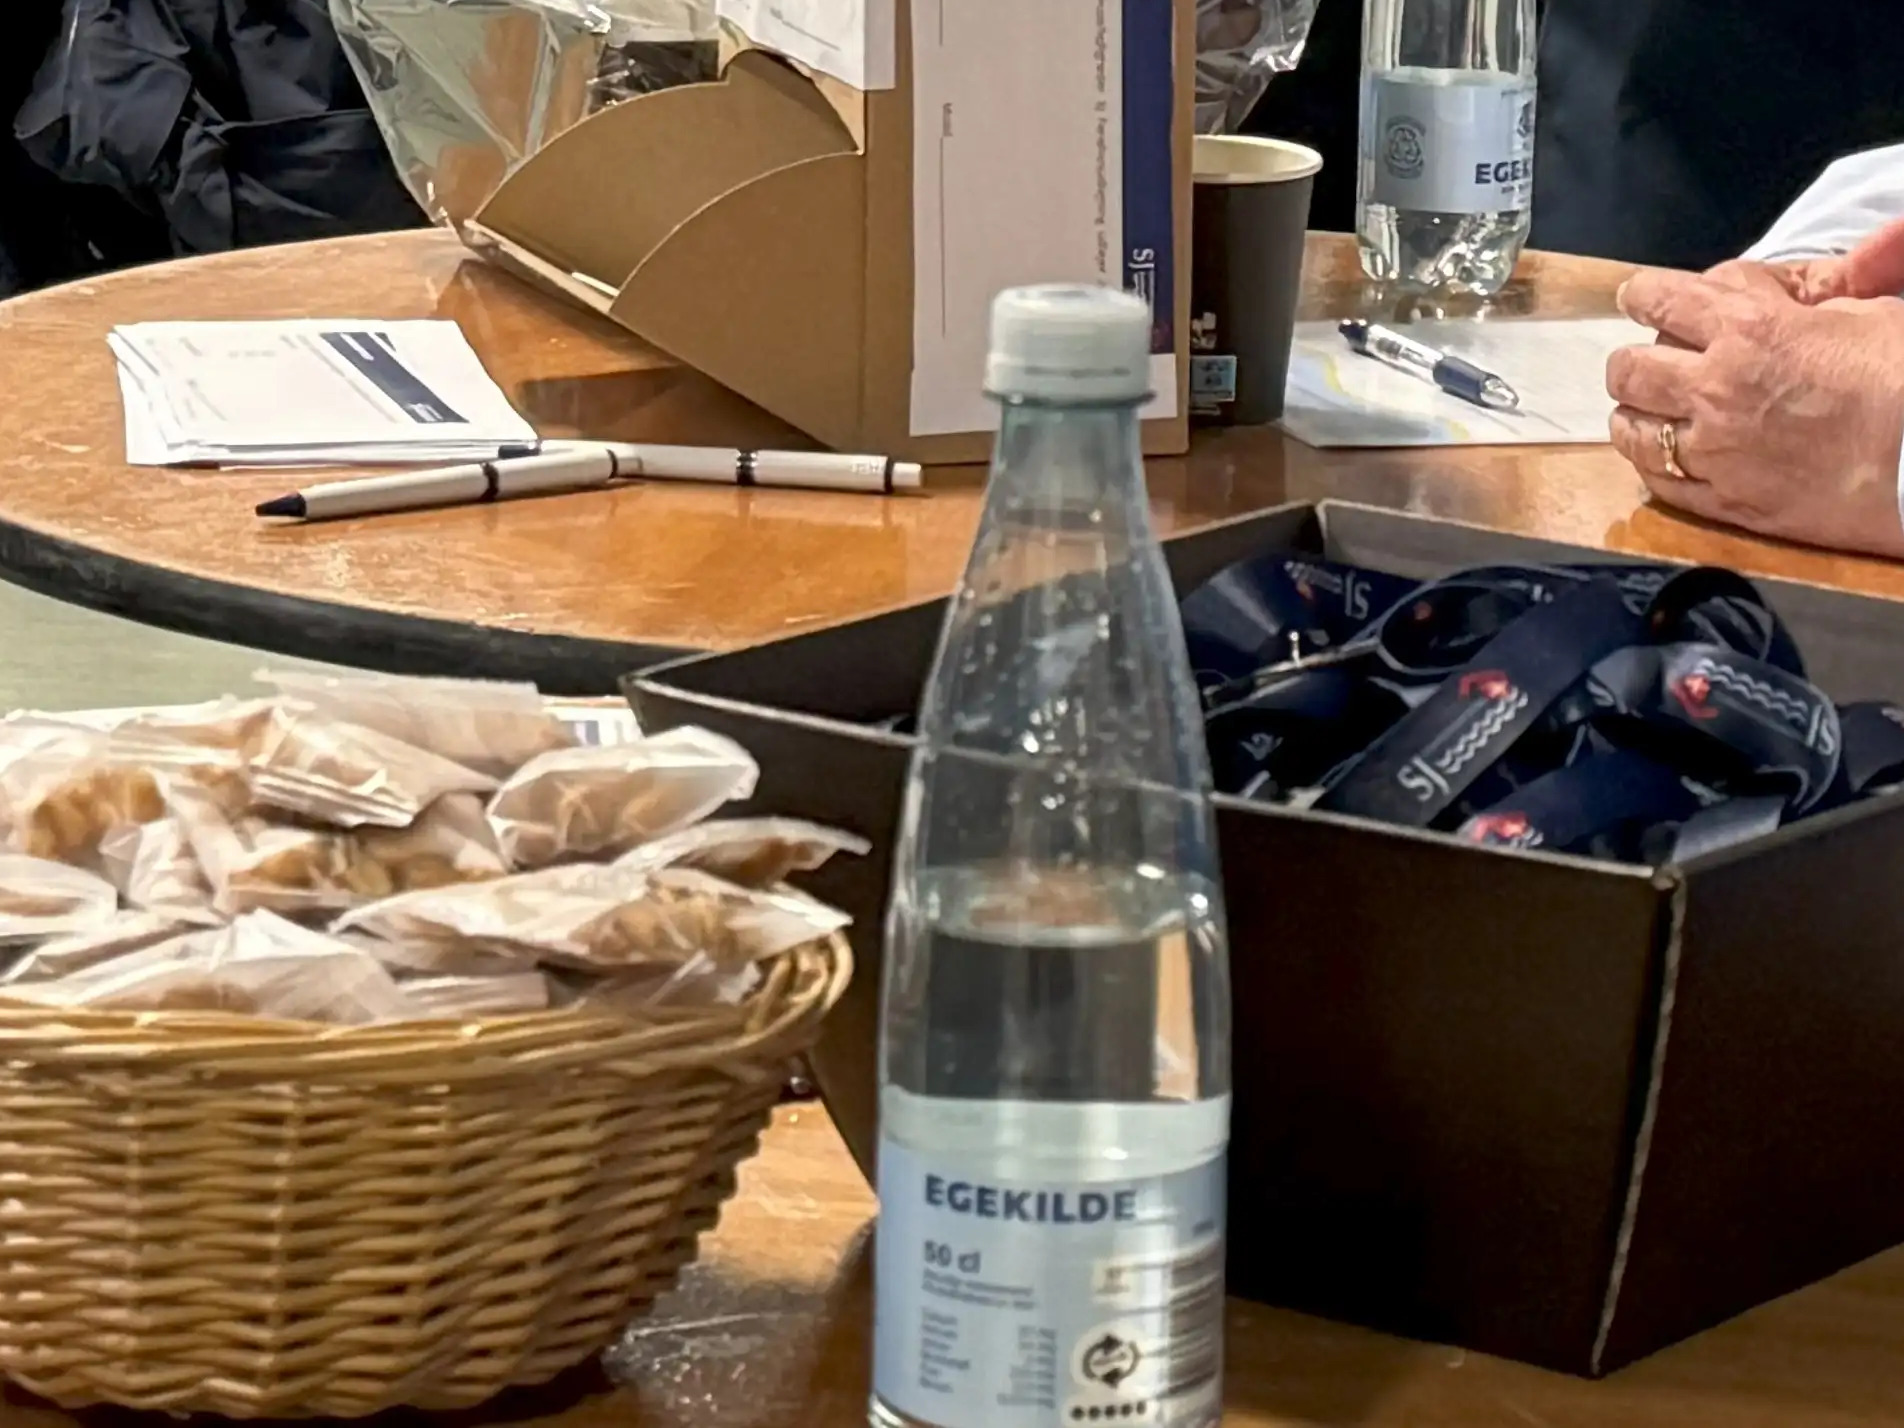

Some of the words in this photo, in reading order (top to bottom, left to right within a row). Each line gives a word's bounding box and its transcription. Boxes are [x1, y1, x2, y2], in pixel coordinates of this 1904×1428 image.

[924, 1174, 1138, 1223] EGEKILDE
[924, 1239, 952, 1267] 50
[958, 1250, 981, 1274] cl
